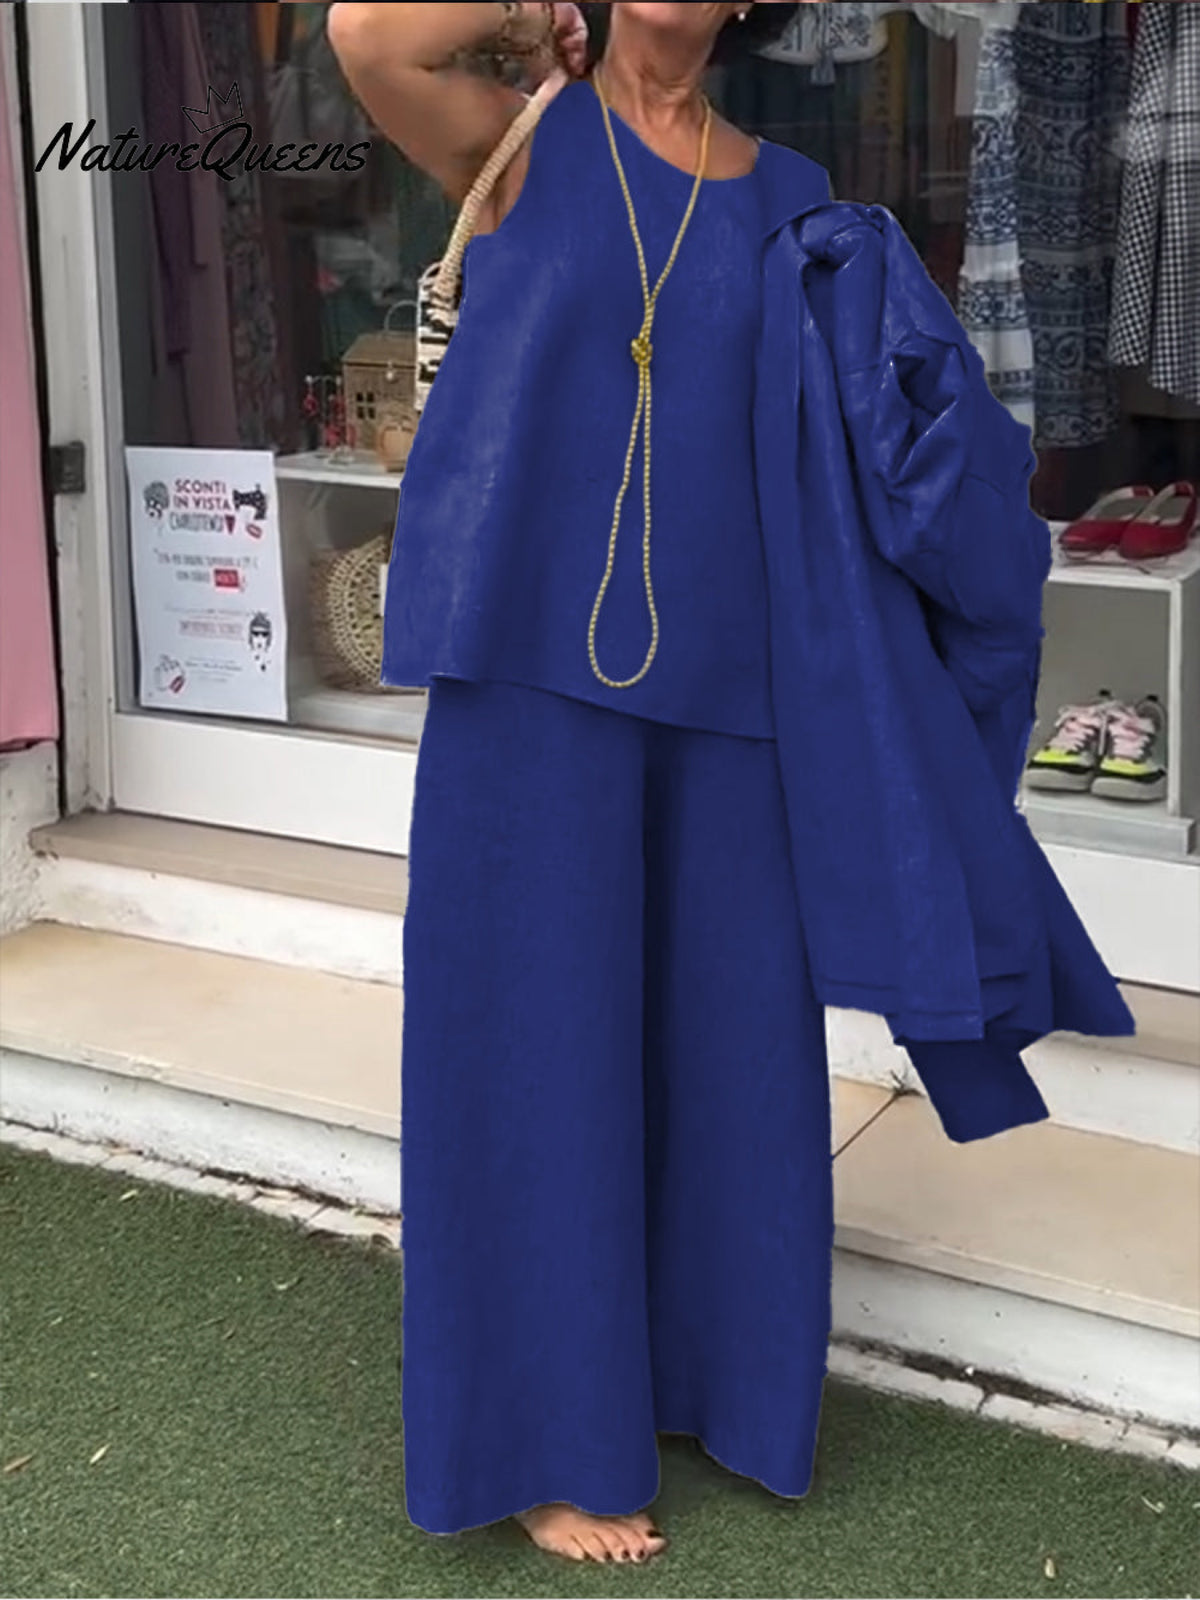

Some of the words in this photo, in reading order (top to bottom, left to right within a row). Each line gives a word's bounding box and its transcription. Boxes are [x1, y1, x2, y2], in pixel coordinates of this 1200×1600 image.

[174, 479, 226, 494] SCONTI
[172, 495, 189, 508] IN
[192, 496, 231, 511] VISTA
